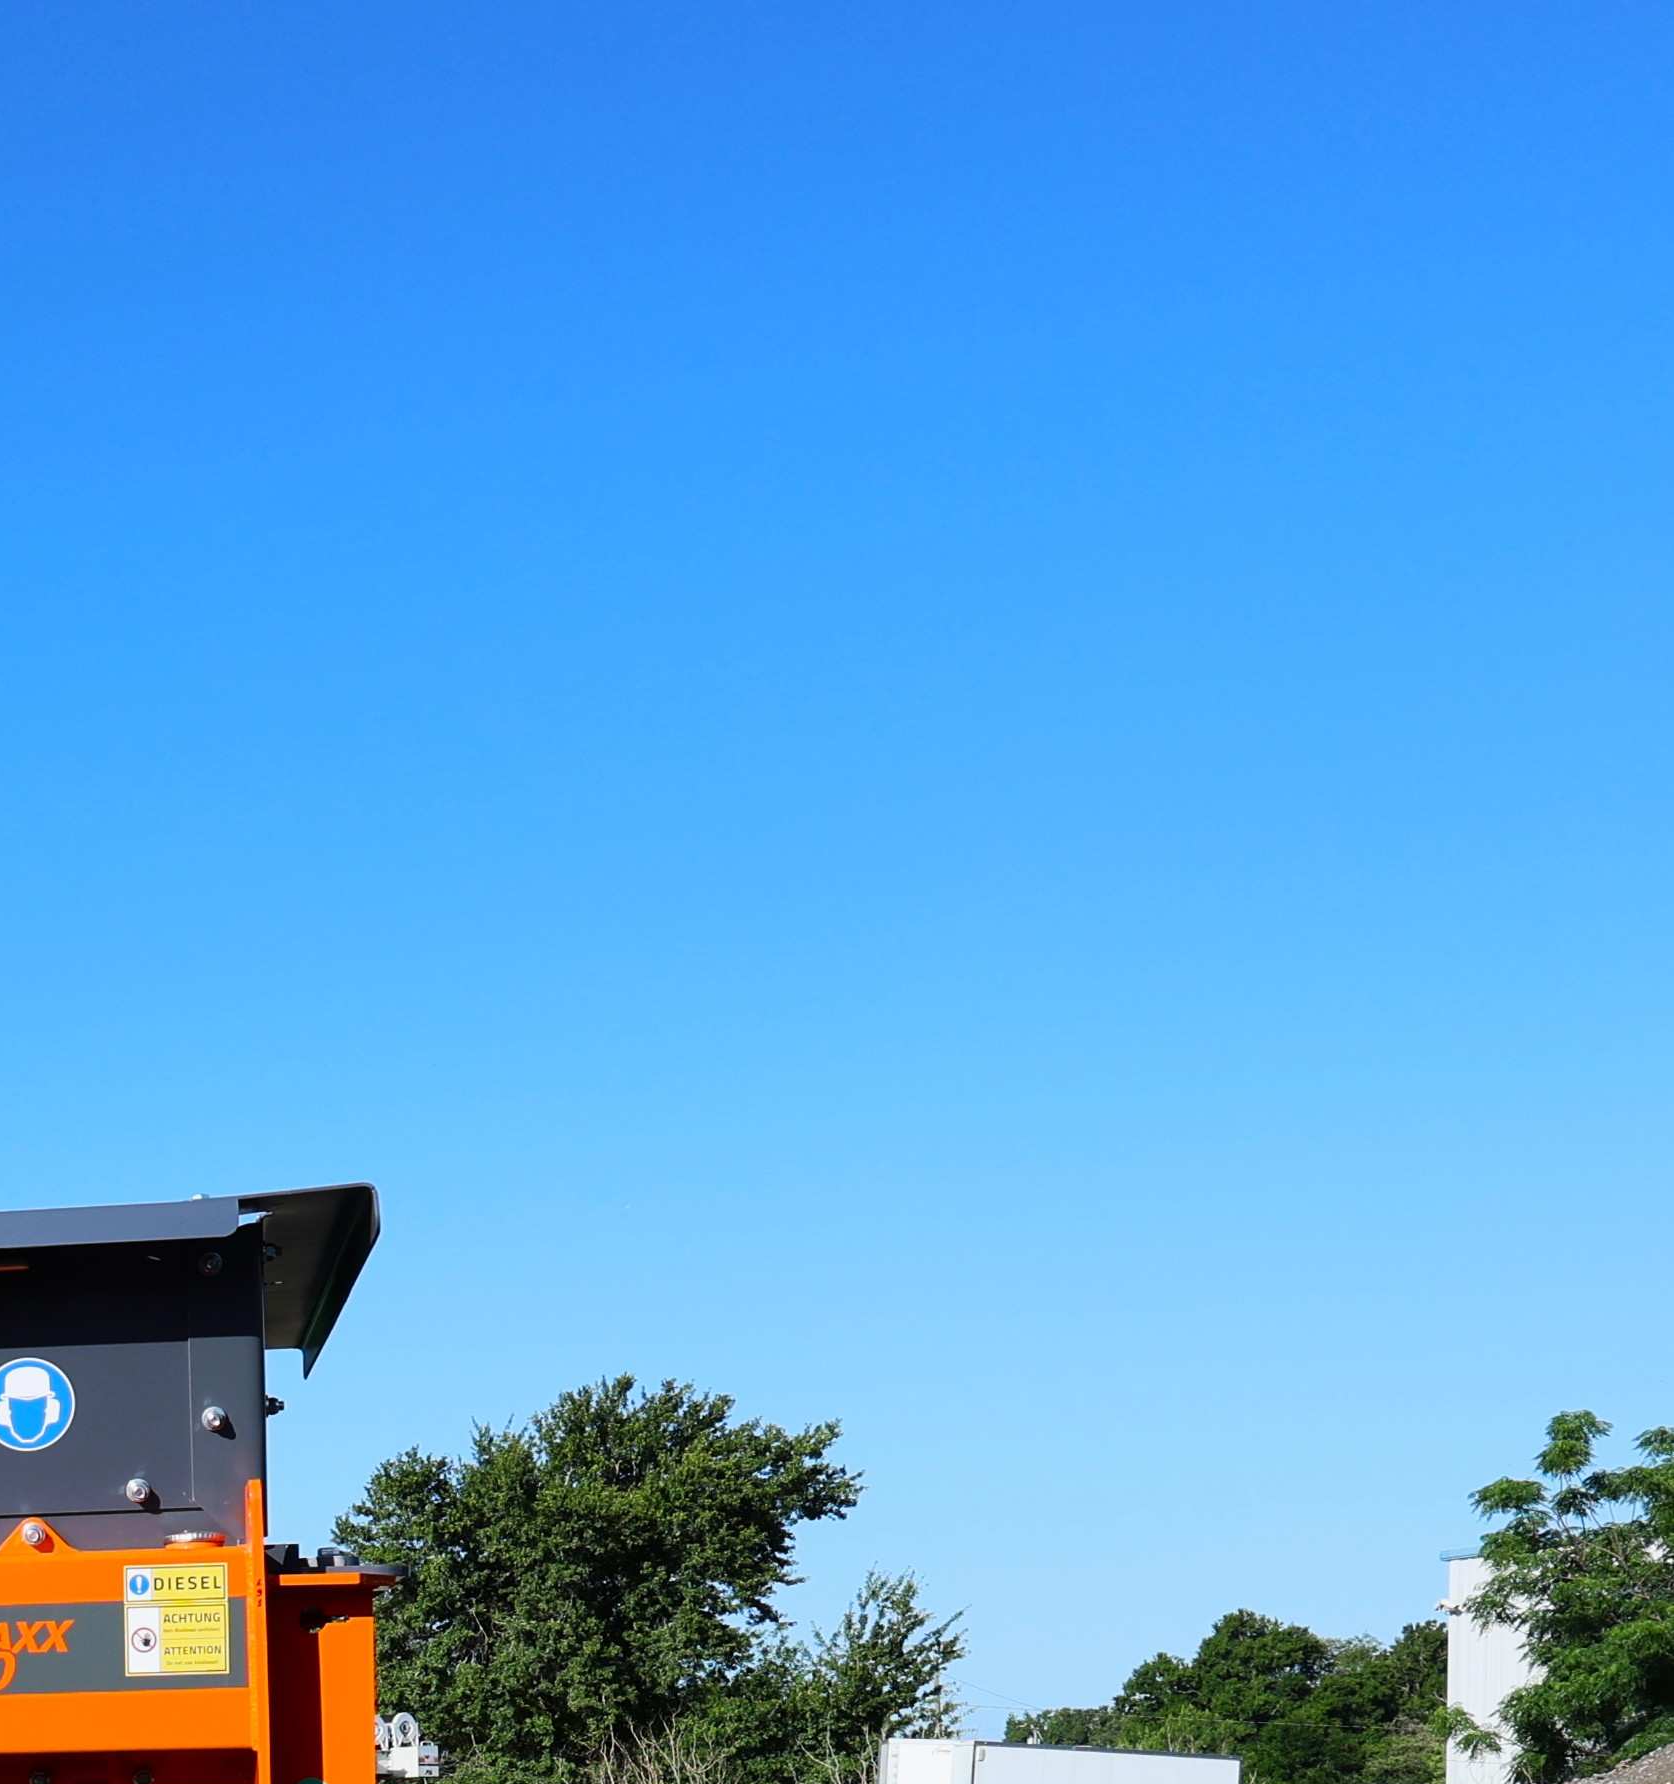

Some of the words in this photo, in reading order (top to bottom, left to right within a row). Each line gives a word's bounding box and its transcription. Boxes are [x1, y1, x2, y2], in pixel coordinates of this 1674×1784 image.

[153, 1575, 222, 1591] DIESEL
[163, 1612, 221, 1624] ACHTUNG
[164, 1645, 222, 1656] ATTENTION
